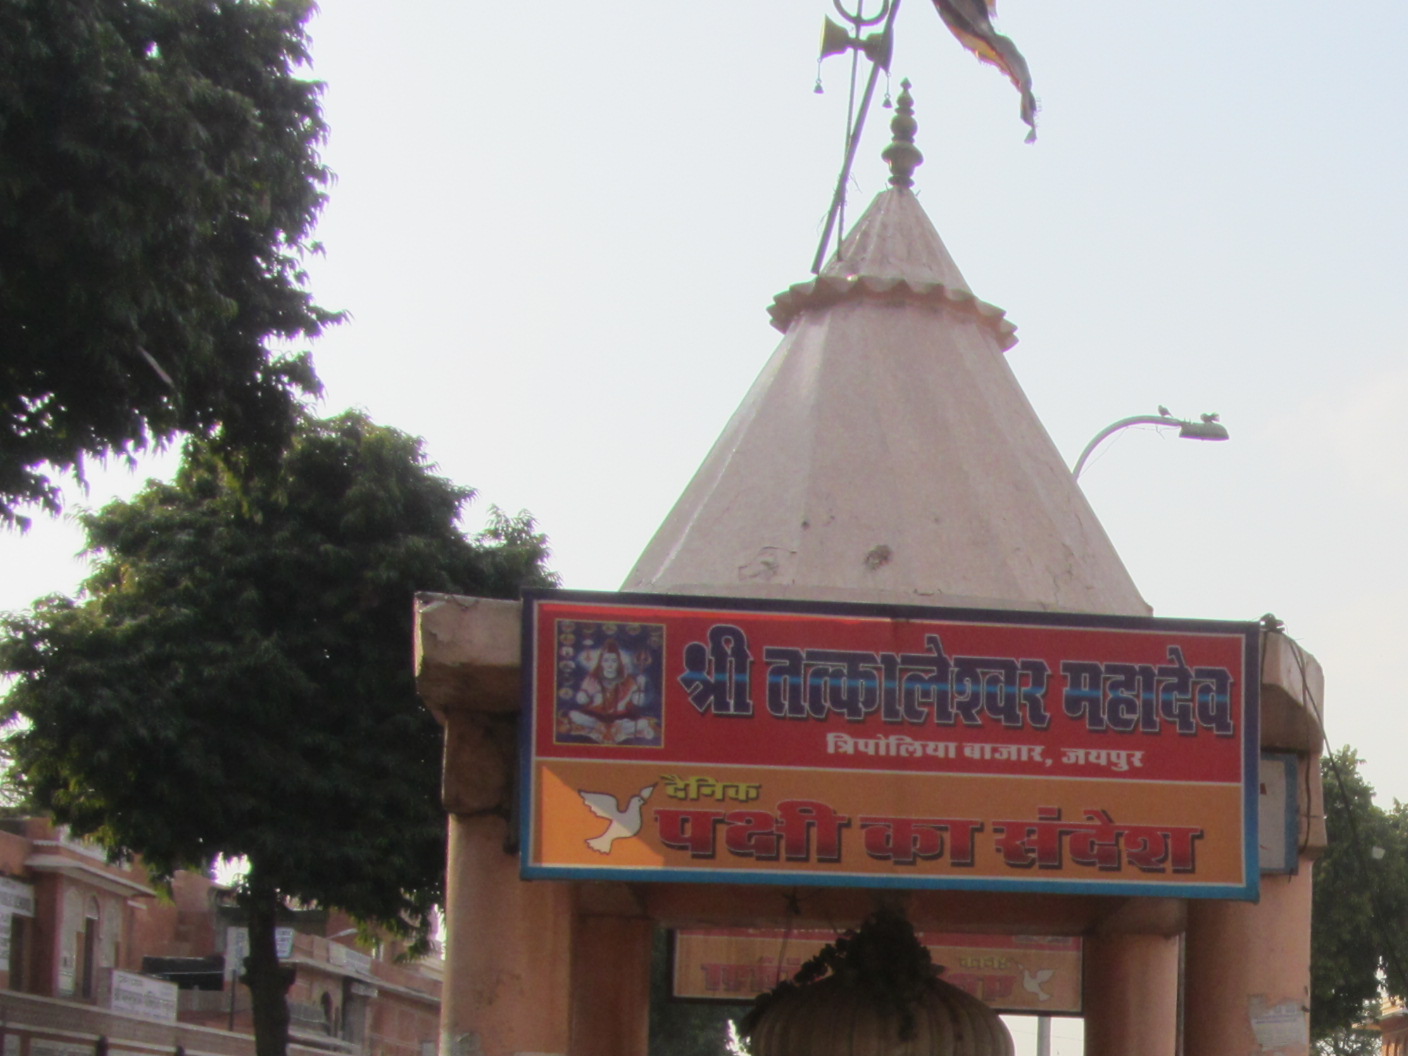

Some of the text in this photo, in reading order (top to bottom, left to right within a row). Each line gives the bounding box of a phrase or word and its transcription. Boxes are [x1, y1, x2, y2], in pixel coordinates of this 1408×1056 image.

[678, 624, 1236, 735] श्री तत्कालेश्वर महादेव
[826, 732, 1145, 771] त्रिपोलिया बाजार, जयपुर
[659, 773, 761, 802] दैनिक
[655, 800, 1203, 873] पक्षी का संदेश
